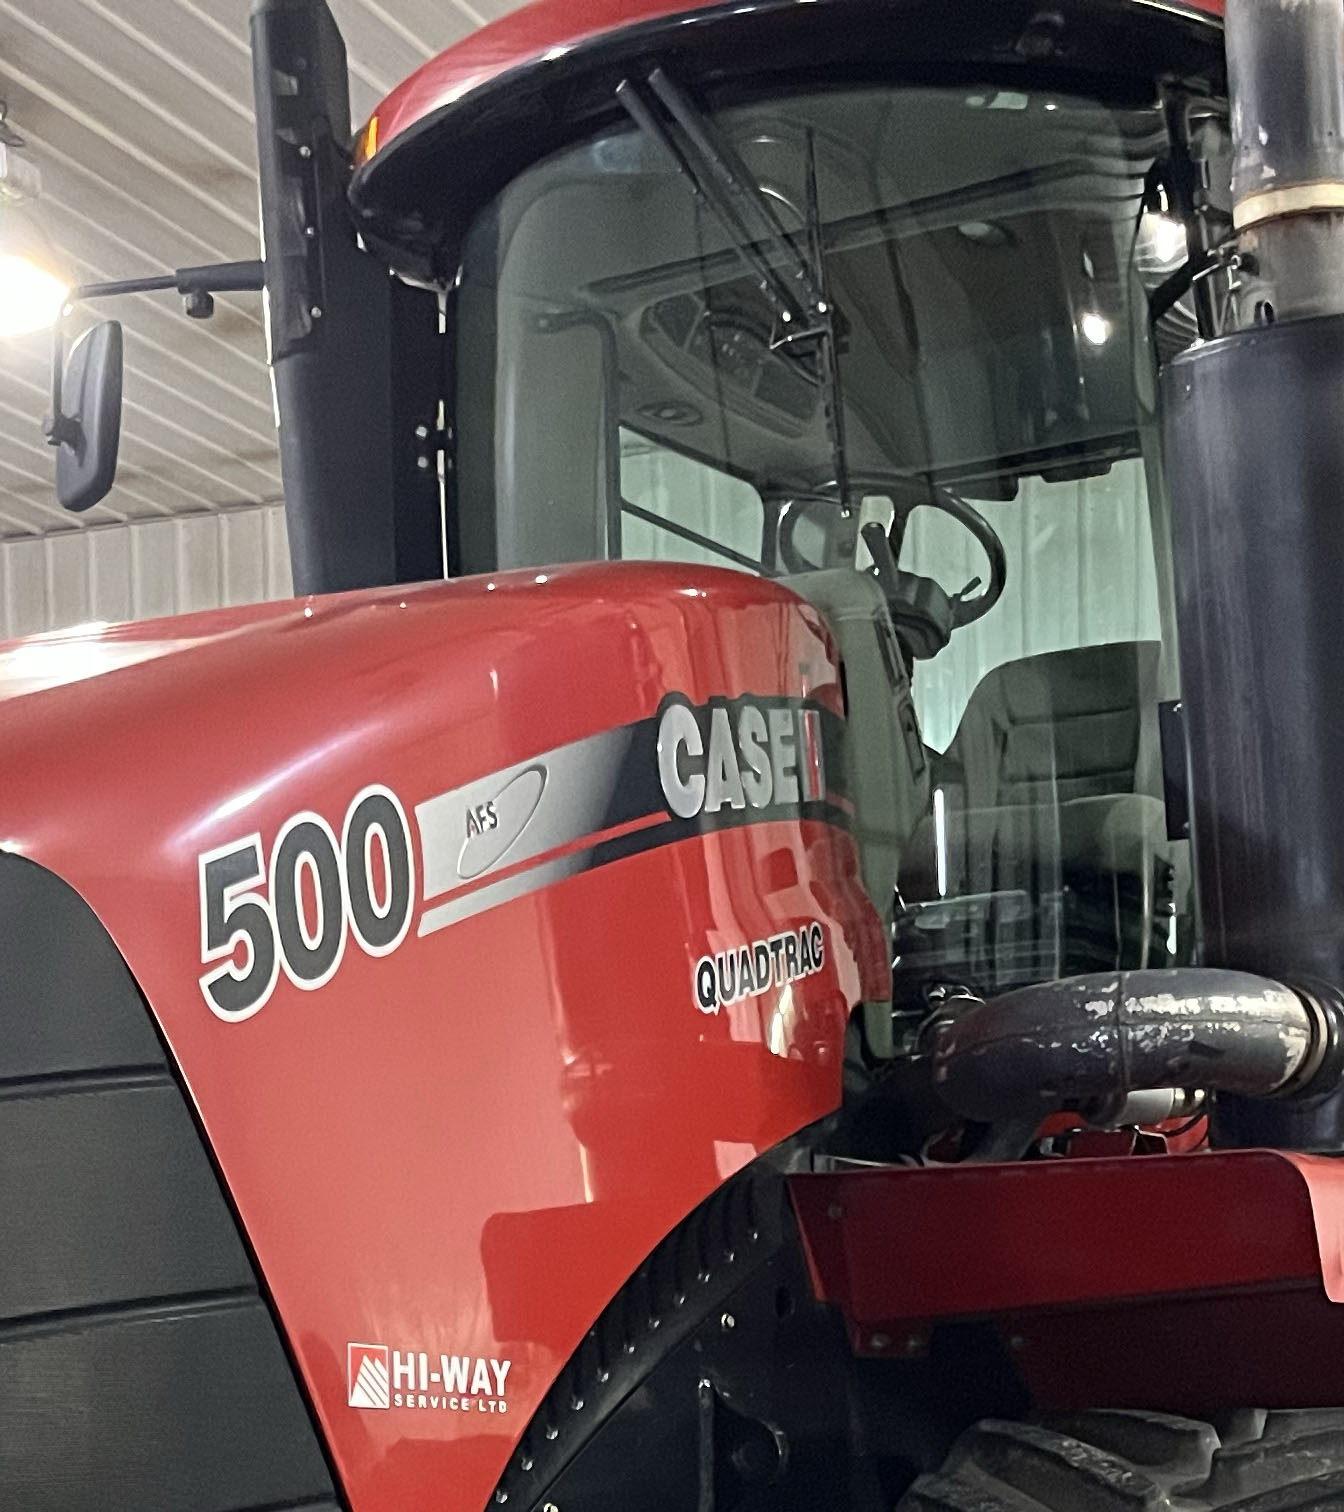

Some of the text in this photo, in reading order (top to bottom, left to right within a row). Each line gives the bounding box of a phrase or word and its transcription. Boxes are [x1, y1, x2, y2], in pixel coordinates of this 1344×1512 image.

[658, 704, 799, 819] CASE
[465, 800, 498, 839] AFS
[198, 783, 416, 1023] 500
[695, 921, 824, 1016] QUADTRAC
[392, 1350, 512, 1397] HI-WAY
[394, 1393, 508, 1414] SERVICE LTD
